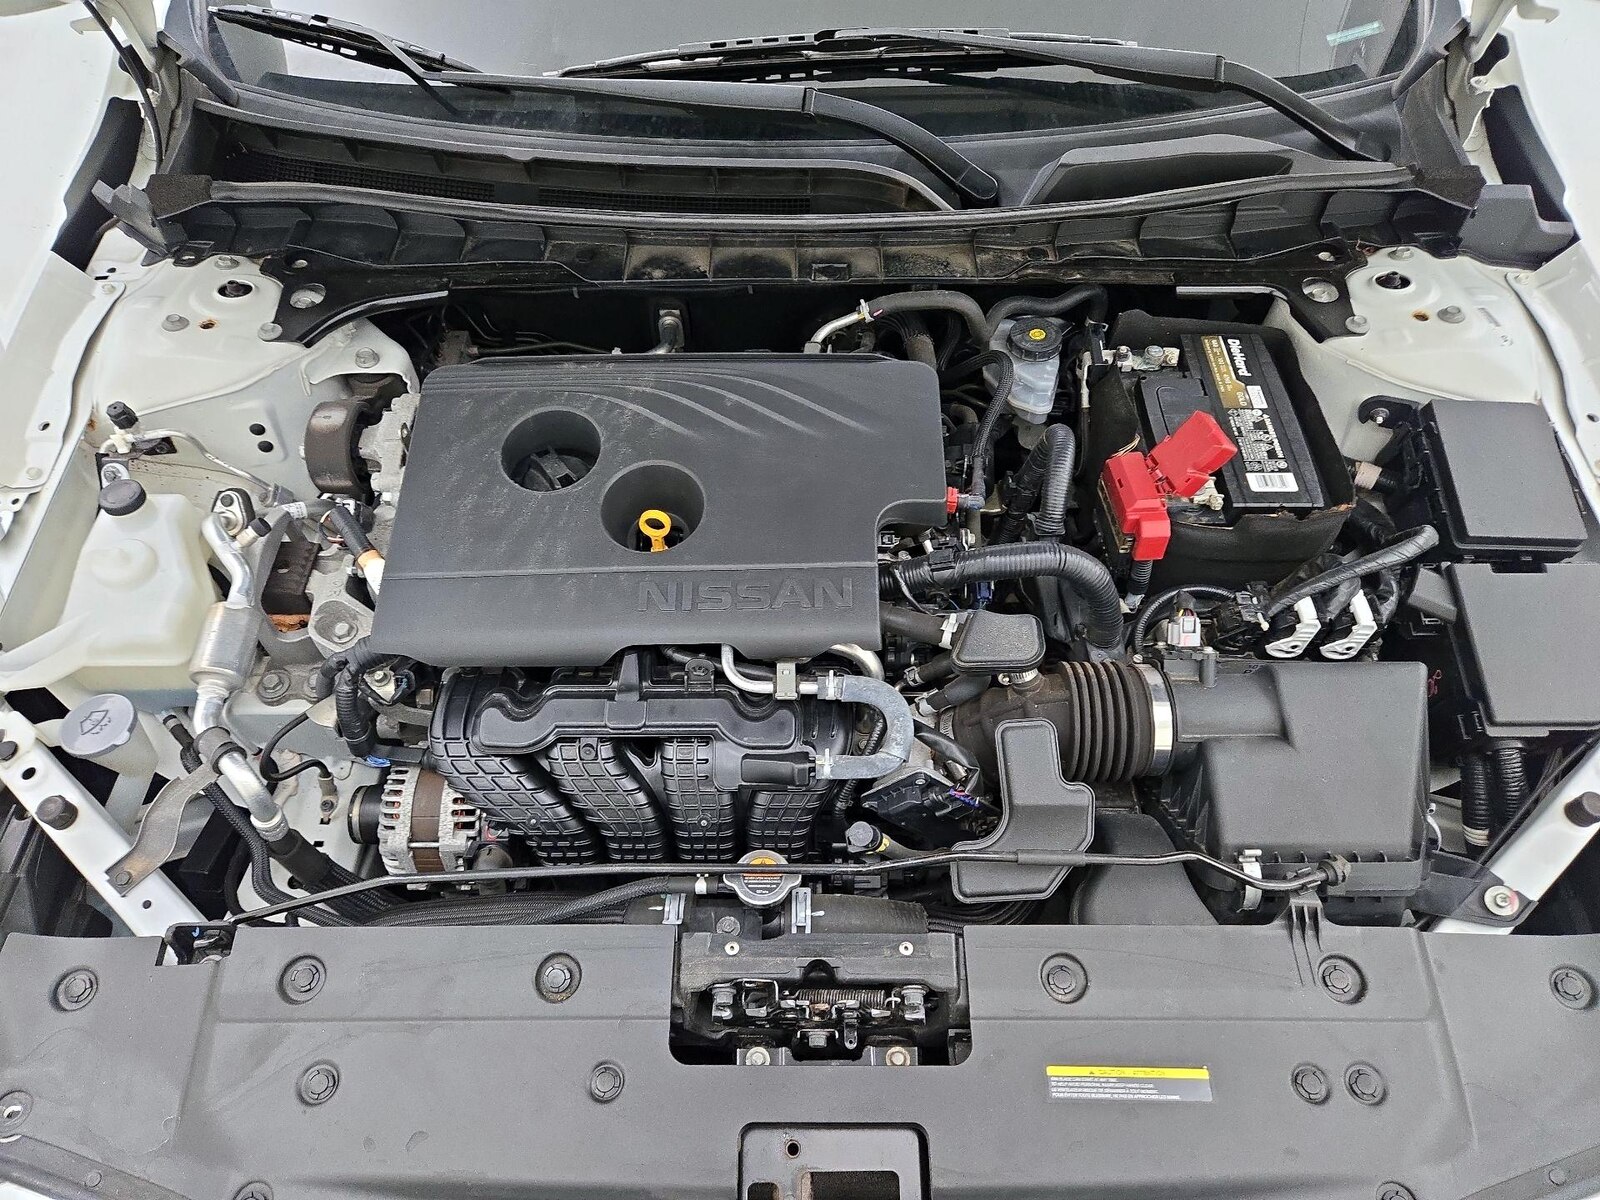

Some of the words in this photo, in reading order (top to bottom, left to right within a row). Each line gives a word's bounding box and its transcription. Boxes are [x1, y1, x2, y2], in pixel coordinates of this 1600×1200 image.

[1227, 338, 1252, 377] DieHard
[1236, 391, 1248, 407] GOLD
[638, 576, 853, 613] NISSAN
